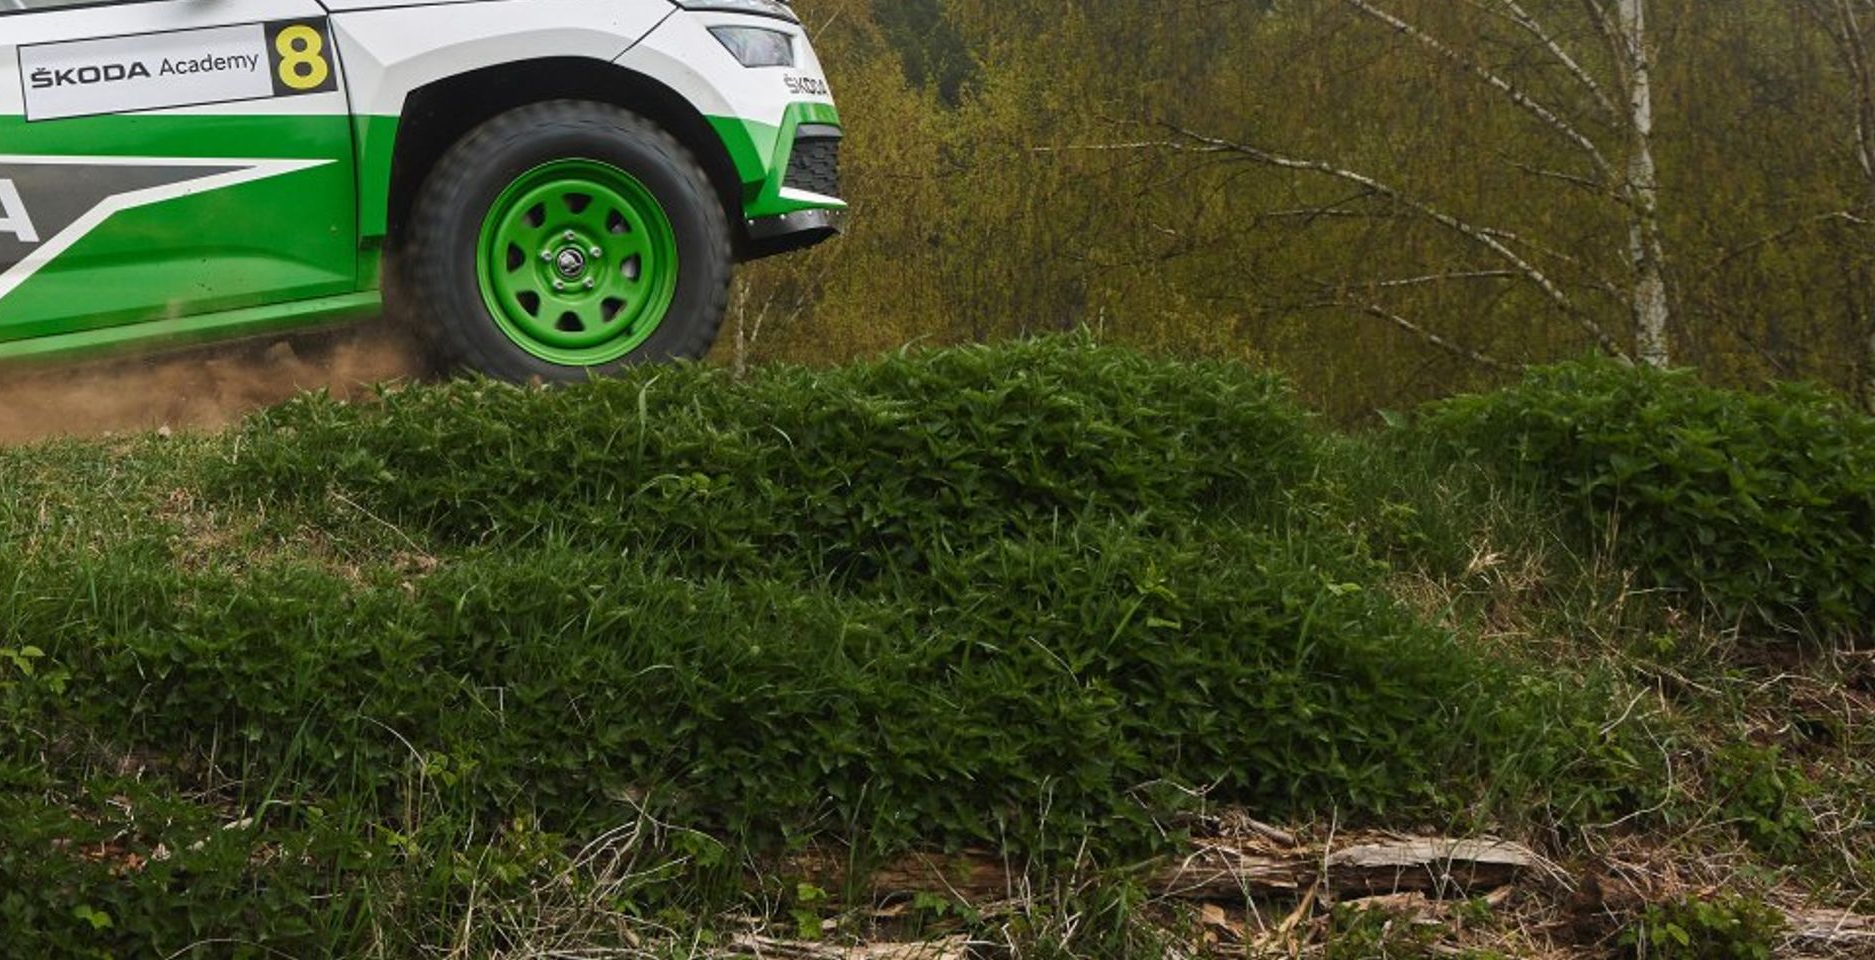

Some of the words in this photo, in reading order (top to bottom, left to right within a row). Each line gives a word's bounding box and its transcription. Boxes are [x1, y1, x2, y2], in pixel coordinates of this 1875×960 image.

[30, 61, 151, 89] ŠKODA
[159, 53, 259, 76] Academy
[275, 23, 329, 90] 8
